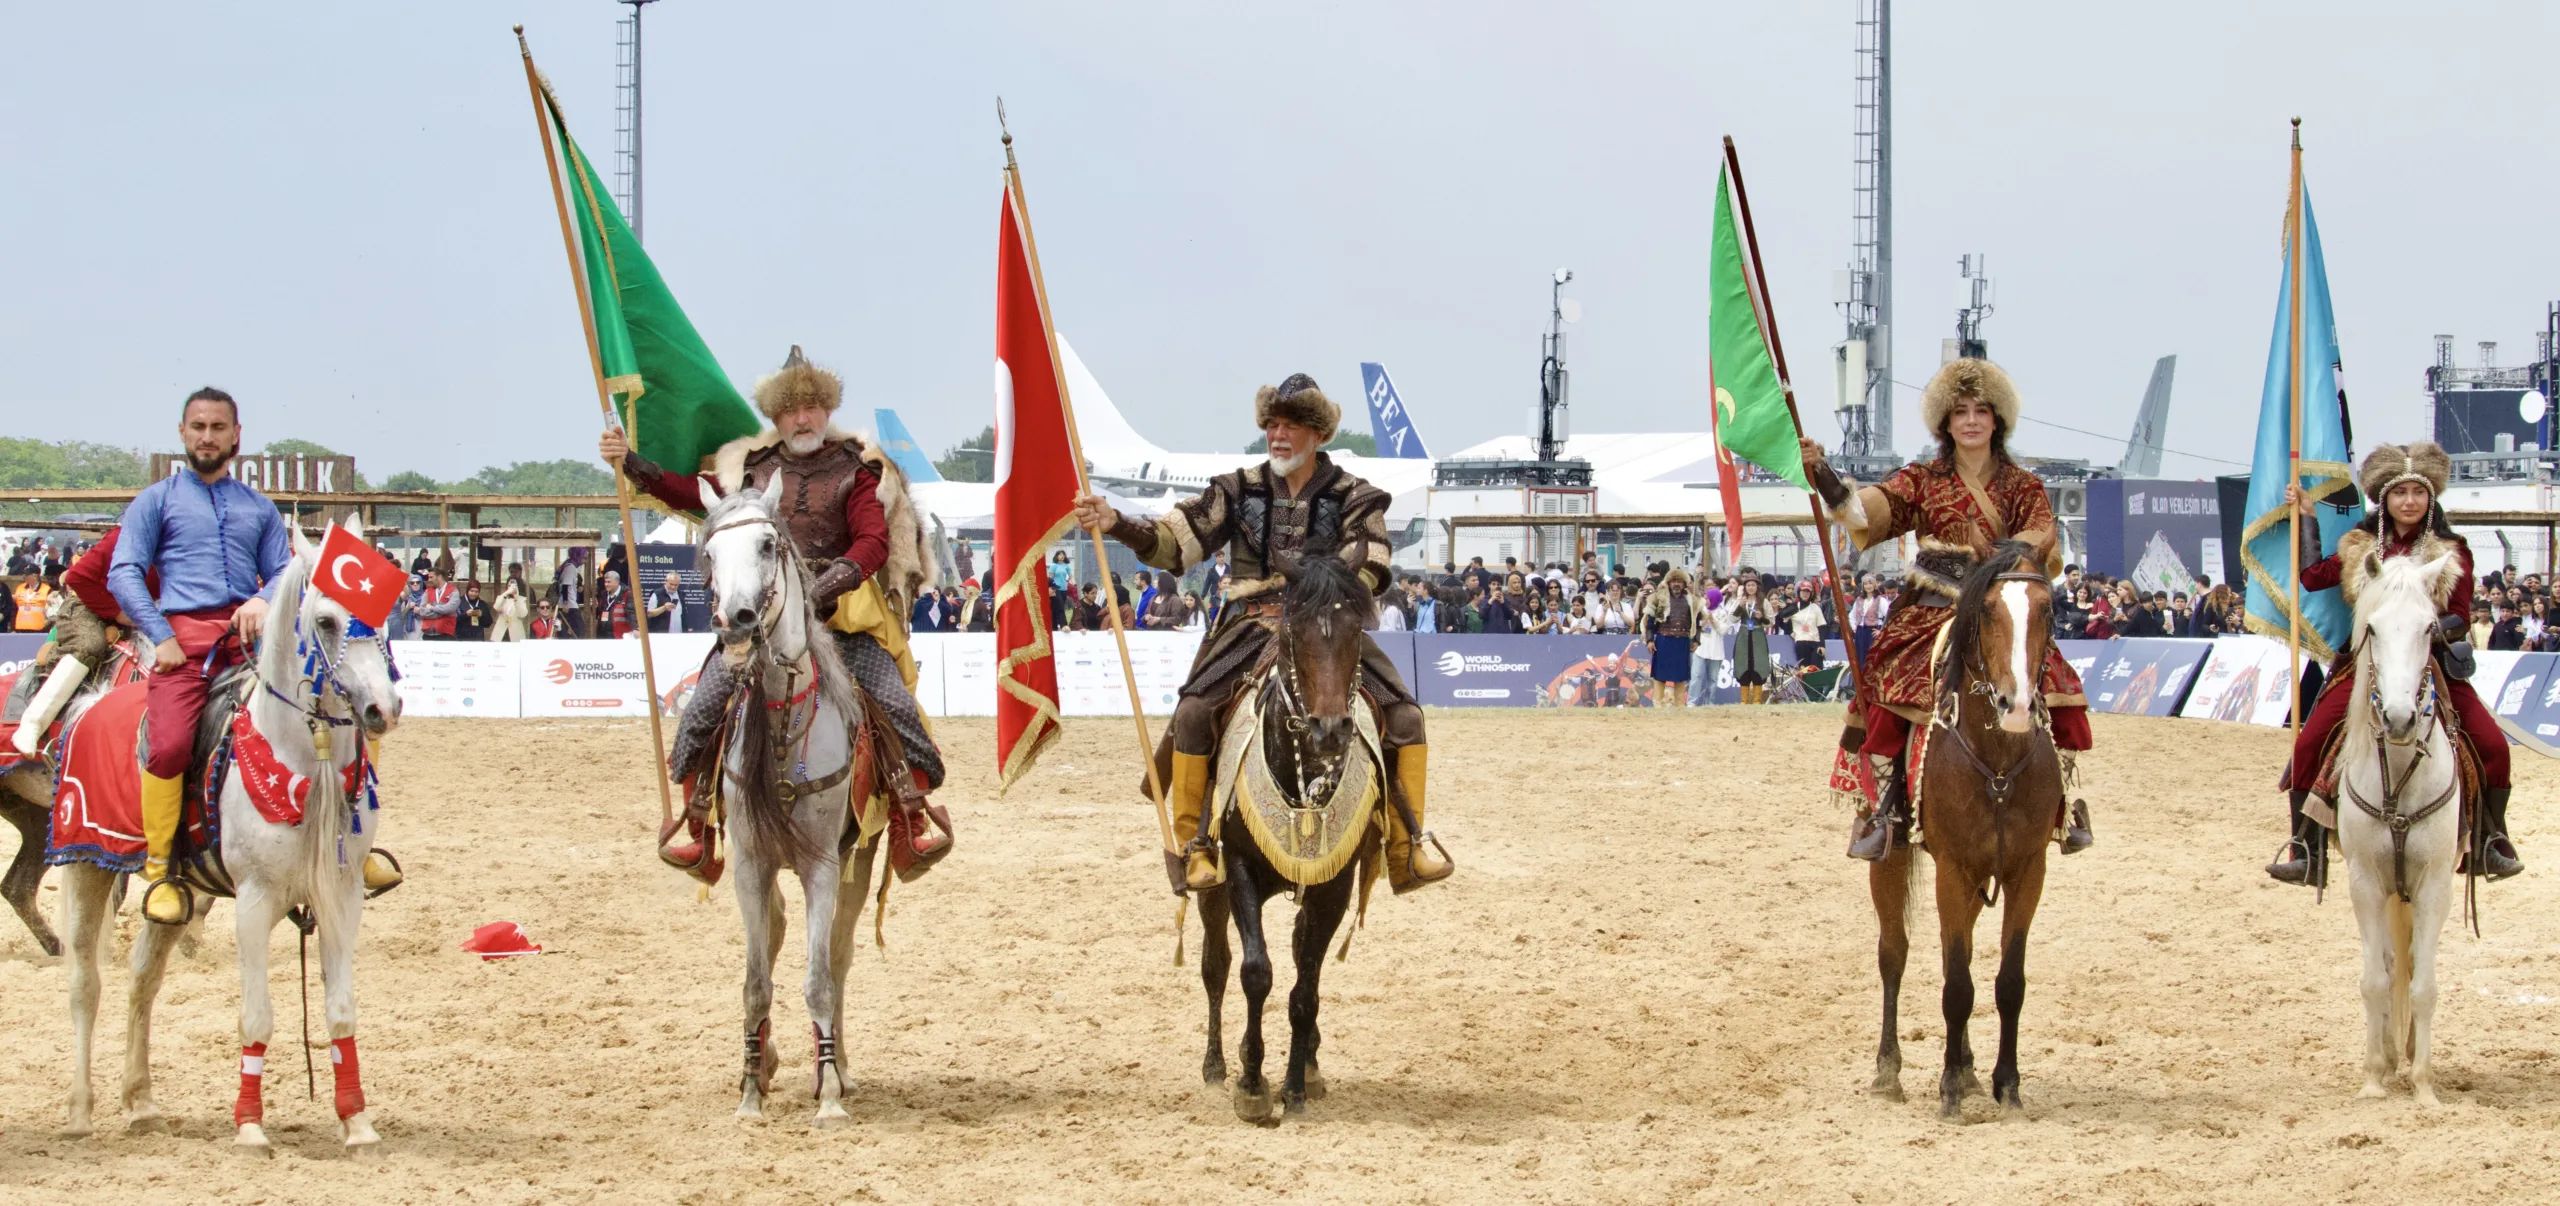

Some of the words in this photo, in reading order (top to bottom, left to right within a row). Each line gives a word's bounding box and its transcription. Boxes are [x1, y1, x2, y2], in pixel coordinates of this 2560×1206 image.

[1369, 372, 1408, 456] BEA
[639, 555, 653, 564] Atlı
[654, 555, 673, 564] Saha
[1464, 655, 1502, 664] WORLD
[574, 662, 614, 671] WORLD
[1465, 663, 1531, 672] ETHNOSPORT
[574, 671, 645, 680] ETHNOSPORT
